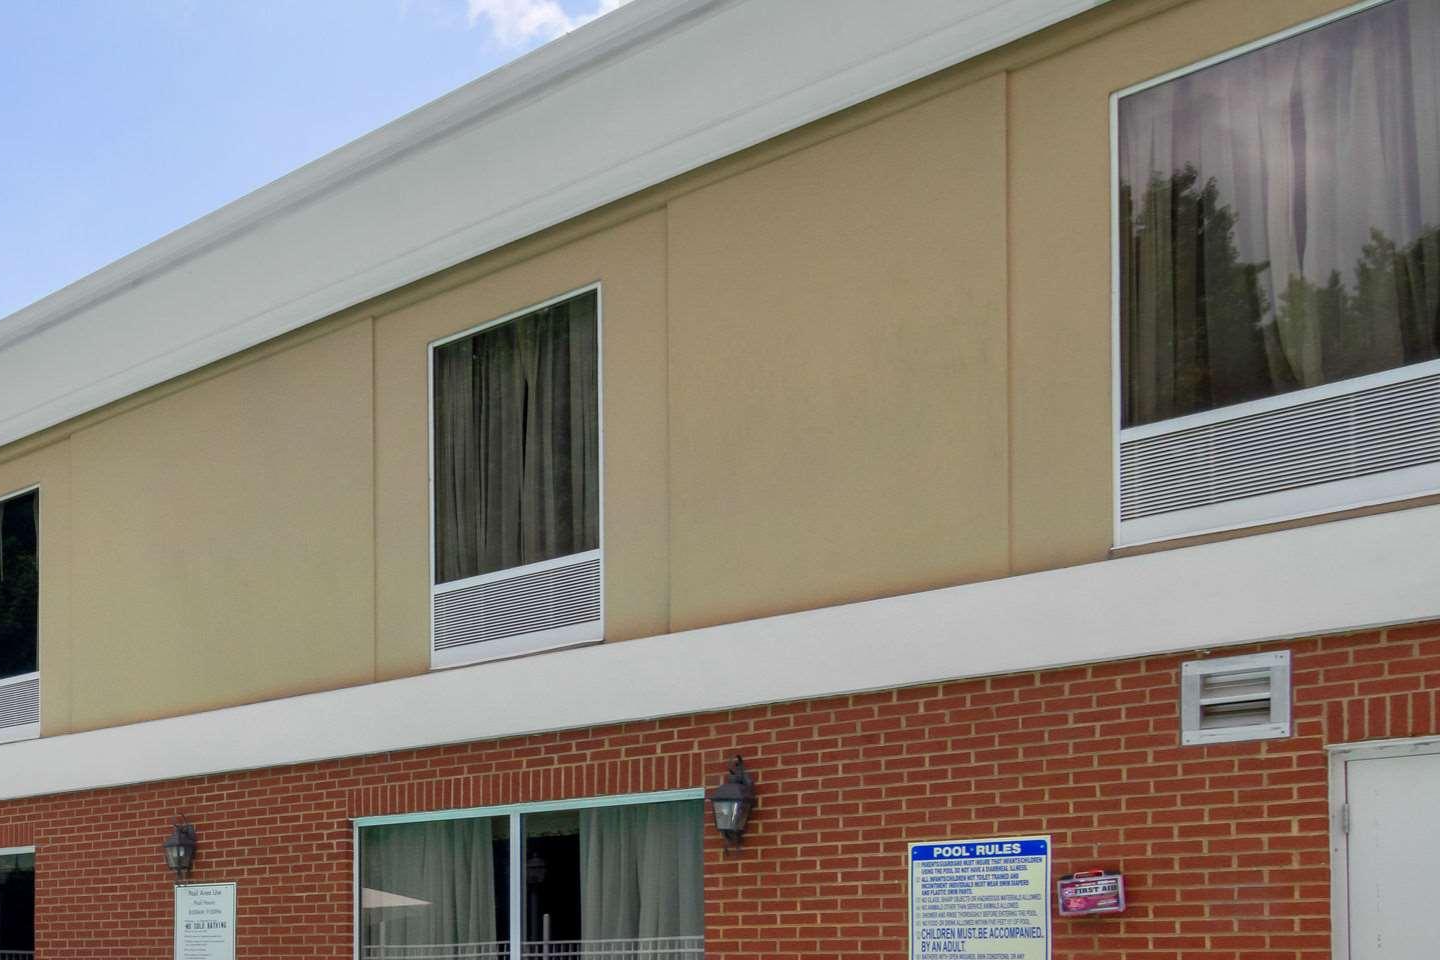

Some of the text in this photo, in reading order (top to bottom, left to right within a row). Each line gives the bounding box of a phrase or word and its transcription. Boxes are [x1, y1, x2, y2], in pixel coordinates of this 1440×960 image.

[933, 843, 1022, 858] POOL RULES
[921, 928, 956, 940] CHILDREN
[956, 928, 977, 939] MUST
[977, 927, 989, 939] BE
[921, 941, 931, 952] BY
[931, 941, 941, 952] AN
